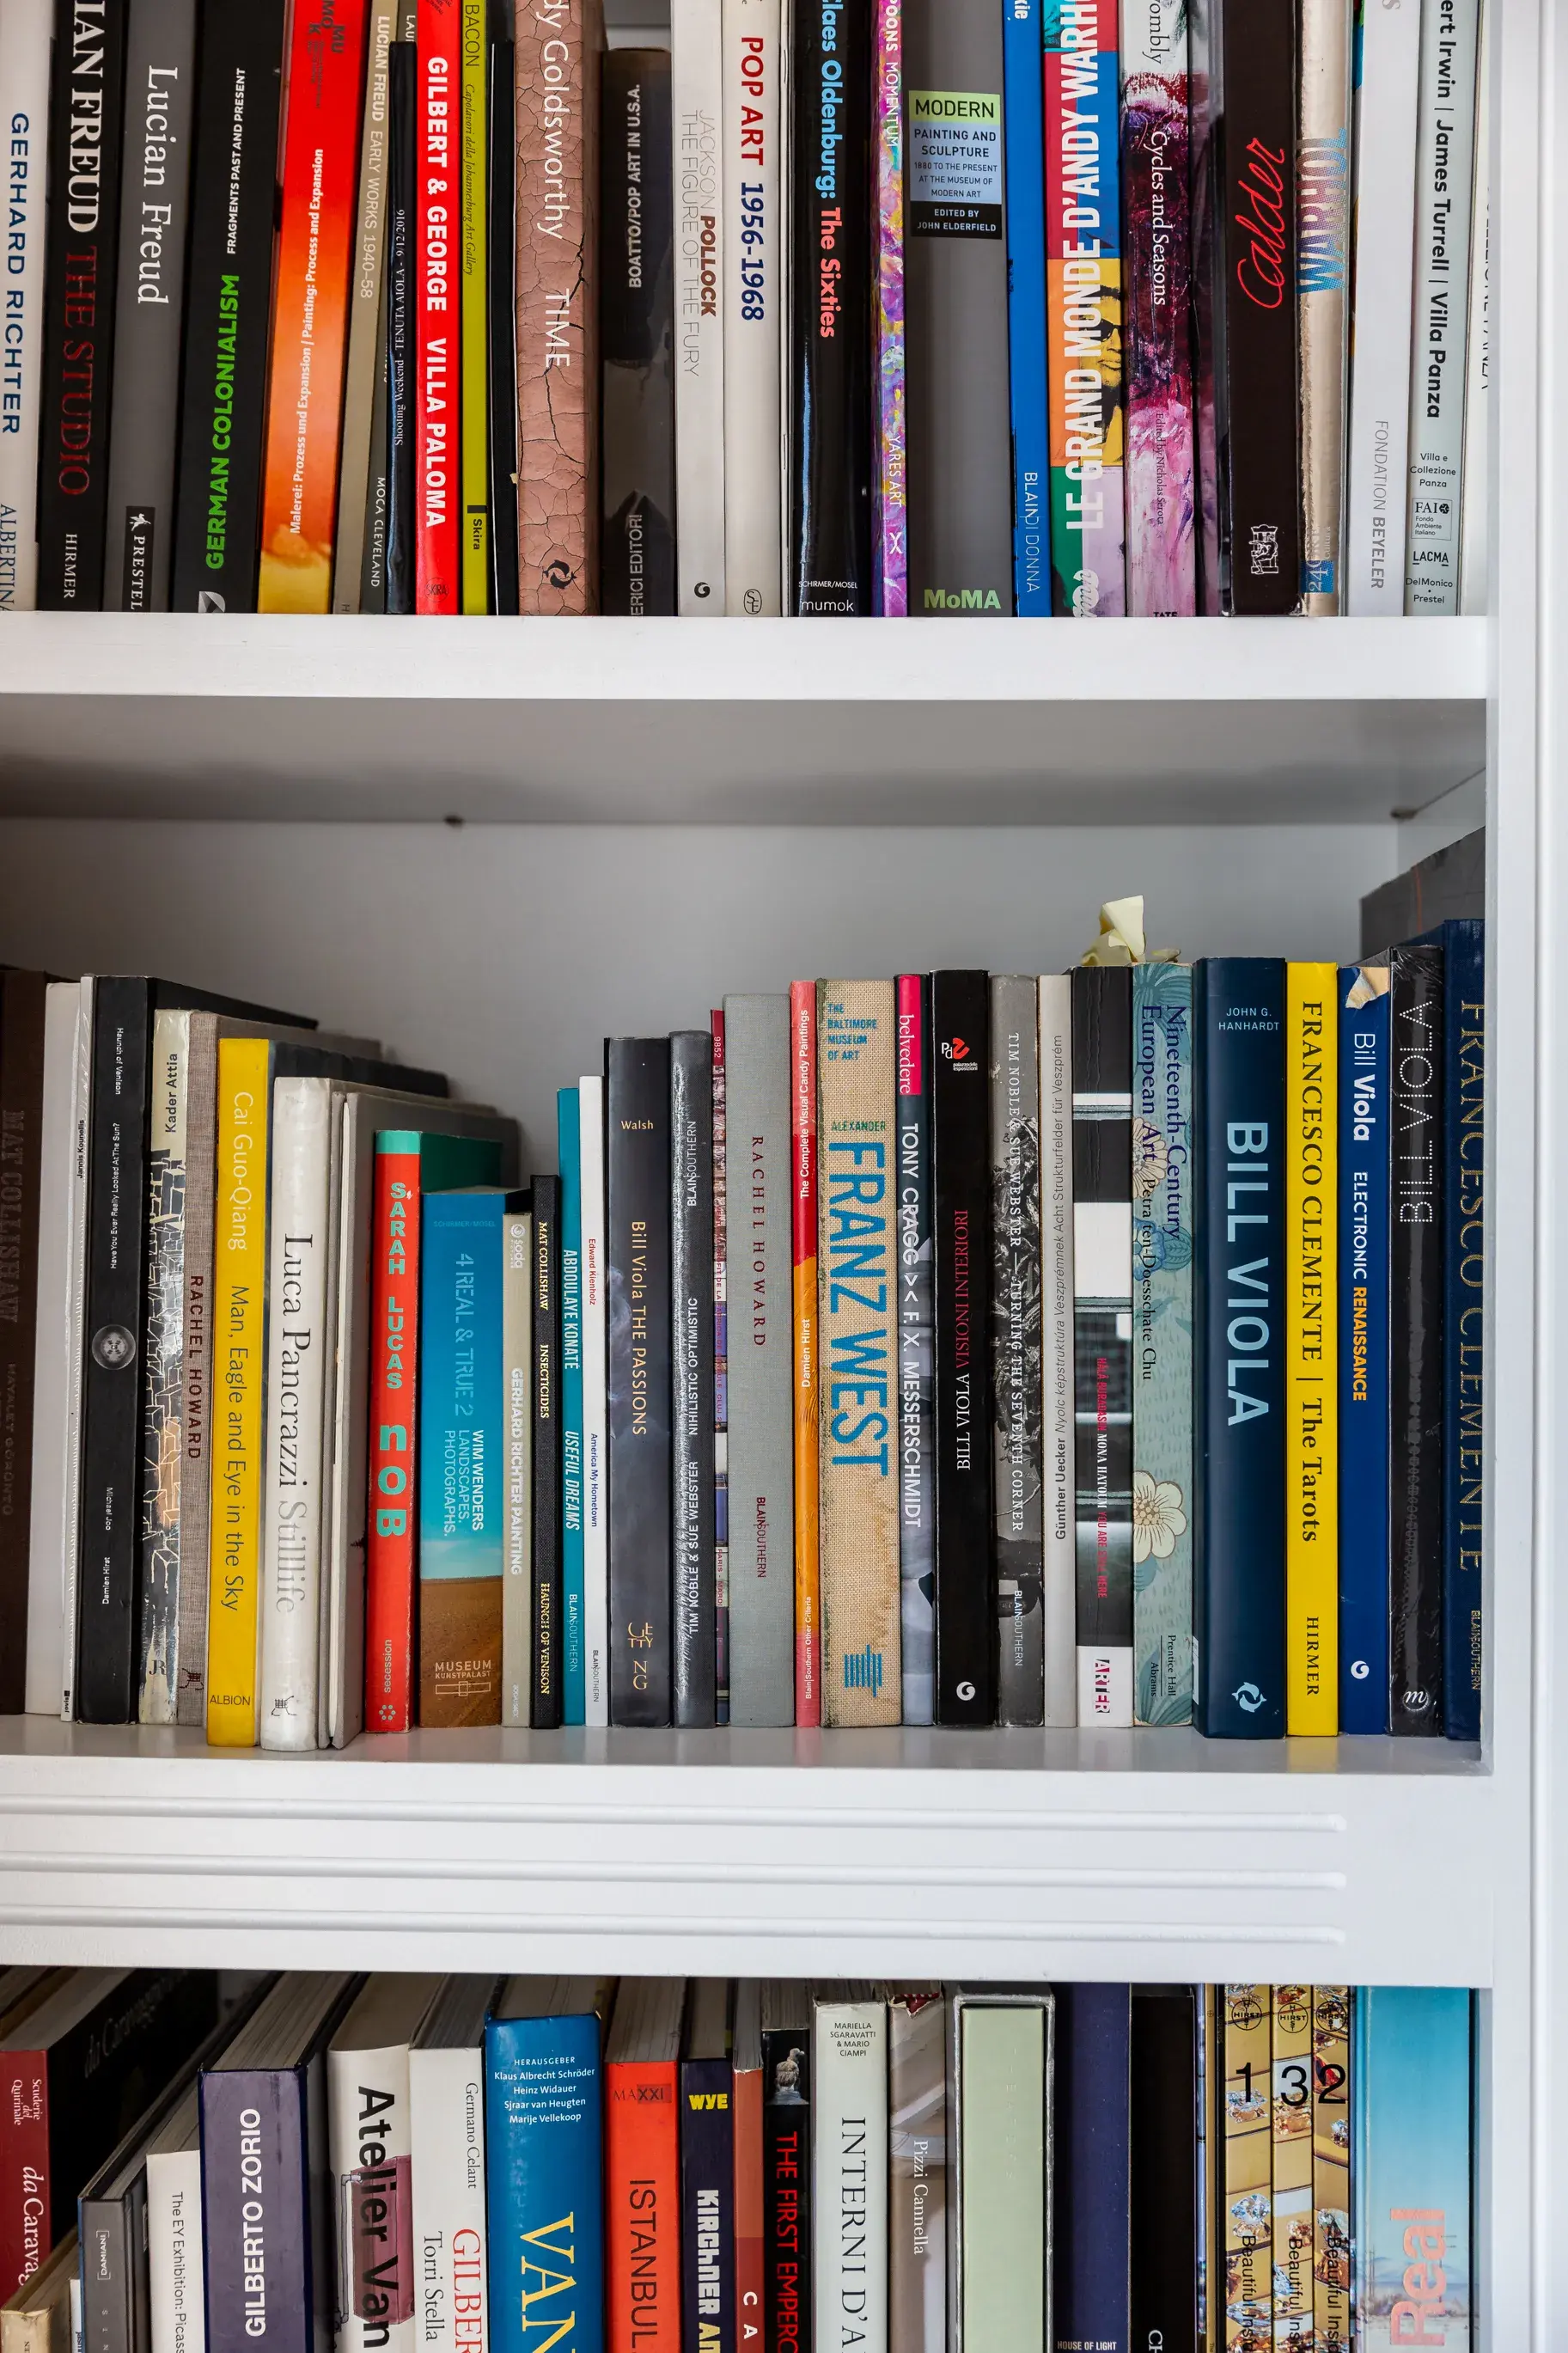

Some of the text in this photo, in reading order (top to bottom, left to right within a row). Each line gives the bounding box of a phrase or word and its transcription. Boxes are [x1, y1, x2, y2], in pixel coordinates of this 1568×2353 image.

[465, 3, 481, 67] BACON
[914, 129, 996, 141] PAINTING AND
[916, 99, 994, 118] MODERN
[922, 146, 989, 156] SCULPTURE
[137, 65, 178, 303] Lucian Freud
[537, 40, 570, 369] Goldsworthy TIME
[741, 37, 765, 321] POP ART 1956-1968
[817, 59, 843, 338] Oldenburg: The Sixties
[1146, 131, 1169, 305] Cycles and Seasons
[1237, 139, 1284, 308] Calder
[1296, 127, 1347, 293] WARHOL
[1426, 40, 1456, 418] Irwin James Turrell Villa Panza
[2, 113, 30, 434] GERHARD RICHTER
[58, 89, 102, 495] FREUD THE STUDIO
[425, 57, 448, 527] GILBERT & GEORGE VILLA PALOMA
[1065, 241, 1101, 357] MONDE
[205, 274, 239, 570] GERMAN COLONIALISM
[1065, 369, 1102, 480] GRAND
[1066, 493, 1103, 530] LE
[1370, 420, 1388, 588] FONDATION BEYELER
[63, 534, 78, 599] HIRMER
[924, 590, 1002, 608] MoMA
[900, 1014, 914, 1093] belvedere
[1138, 1005, 1161, 1161] European Art
[1353, 1034, 1375, 1140] Bill Viola
[1399, 1001, 1432, 1223] BILL VIOLA
[621, 1120, 654, 1129] Walsh
[1162, 1005, 1187, 1238] Nineteenth-Century
[283, 1234, 313, 1315] Luca
[387, 1183, 406, 1389] SARAH LUCAS
[752, 1137, 766, 1346] RACHEL HOWARD
[1227, 1122, 1269, 1426] BILL VIOLA
[1302, 1001, 1323, 1542] FRANCESCO CLEMENTE The Tarots
[1353, 1172, 1367, 1400] ELECTRONIC RENAISSANCE
[188, 1276, 203, 1459] RACHEL HOWARD
[221, 1092, 253, 1611] Cai Guo-Qiang Man, Eagle and Eye in the Sky
[539, 1222, 549, 1418] MAT COLLISHAW INSECTICIDES
[563, 1250, 580, 1369] ABDOULAYE KONATÉ
[632, 1221, 646, 1435] Bill Viola THE PASSIONS
[829, 1142, 888, 1476] FRANZ WEST
[903, 1124, 920, 1527] TONY CRAGG F. X. MESSERSCHMIDT
[955, 1209, 970, 1470] BILL VIOLA VISIONI INTERIORI
[279, 1328, 310, 1488] Pancrazzi
[443, 1430, 455, 1536] PHOTOGRAPHS.
[457, 1430, 469, 1523] LANDSCAPES.
[473, 1430, 483, 1531] WIM WENDERS
[564, 1431, 579, 1530] USEFUL DREAMS
[210, 1696, 250, 1705] ALBION
[1307, 1617, 1319, 1696] HIRMER
[11, 2080, 22, 2124] Quirinale
[32, 2079, 42, 2120] Scuderie
[494, 2069, 595, 2081] Klaus Albrecht Schröder
[504, 2099, 528, 2110] Sjraar
[549, 2097, 586, 2109] Heugten
[509, 2112, 582, 2124] Marije Vellekoop
[514, 2084, 577, 2095] Heinz Widauer
[515, 2057, 576, 2066] HERAUSGEBER
[613, 2085, 664, 2100] MAXXI
[1236, 2063, 1251, 2102] 1
[1281, 2065, 1308, 2105] 3
[1318, 2064, 1345, 2103] 2
[465, 2083, 479, 2188] Germano Celant
[776, 2131, 797, 2252] THE FIRST
[240, 2109, 265, 2337] GILBERTO ZORIO
[358, 2086, 398, 2346] Atelier Van
[841, 2118, 866, 2273] INTERNI
[913, 2140, 928, 2255] Pizzi Cannella
[424, 2231, 443, 2341] Torri Stella
[1390, 2208, 1446, 2347] Real
[1057, 2341, 1117, 2350] HOUSE OF LIGHT
